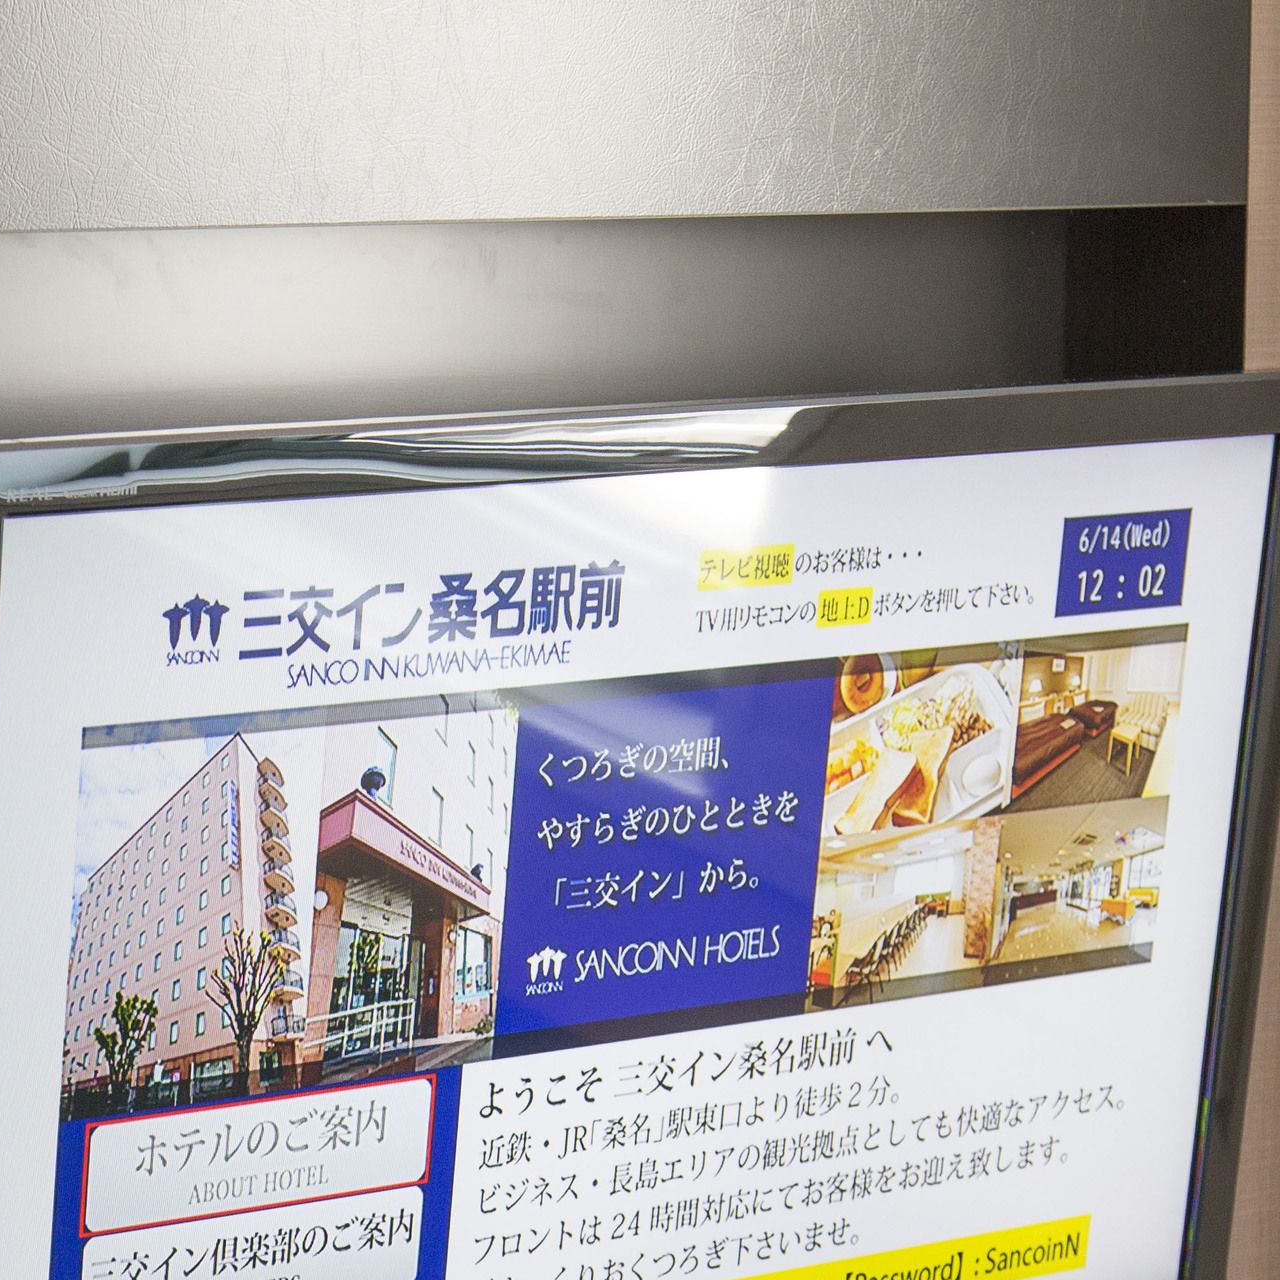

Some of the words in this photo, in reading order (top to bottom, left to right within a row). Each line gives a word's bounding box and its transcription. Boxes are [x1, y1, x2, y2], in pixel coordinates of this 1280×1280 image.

[1077, 523, 1172, 556] 6/14(Wed)
[238, 558, 627, 661] 三交イン桑名駅前
[537, 736, 730, 788] くつろぎの空間、
[537, 790, 800, 850] やすらぎのひとときを
[703, 924, 781, 966] HOTELS
[135, 1099, 388, 1177] ホテルのご案内
[188, 1173, 259, 1206] ABOUT
[263, 1164, 330, 1194] HOTEL
